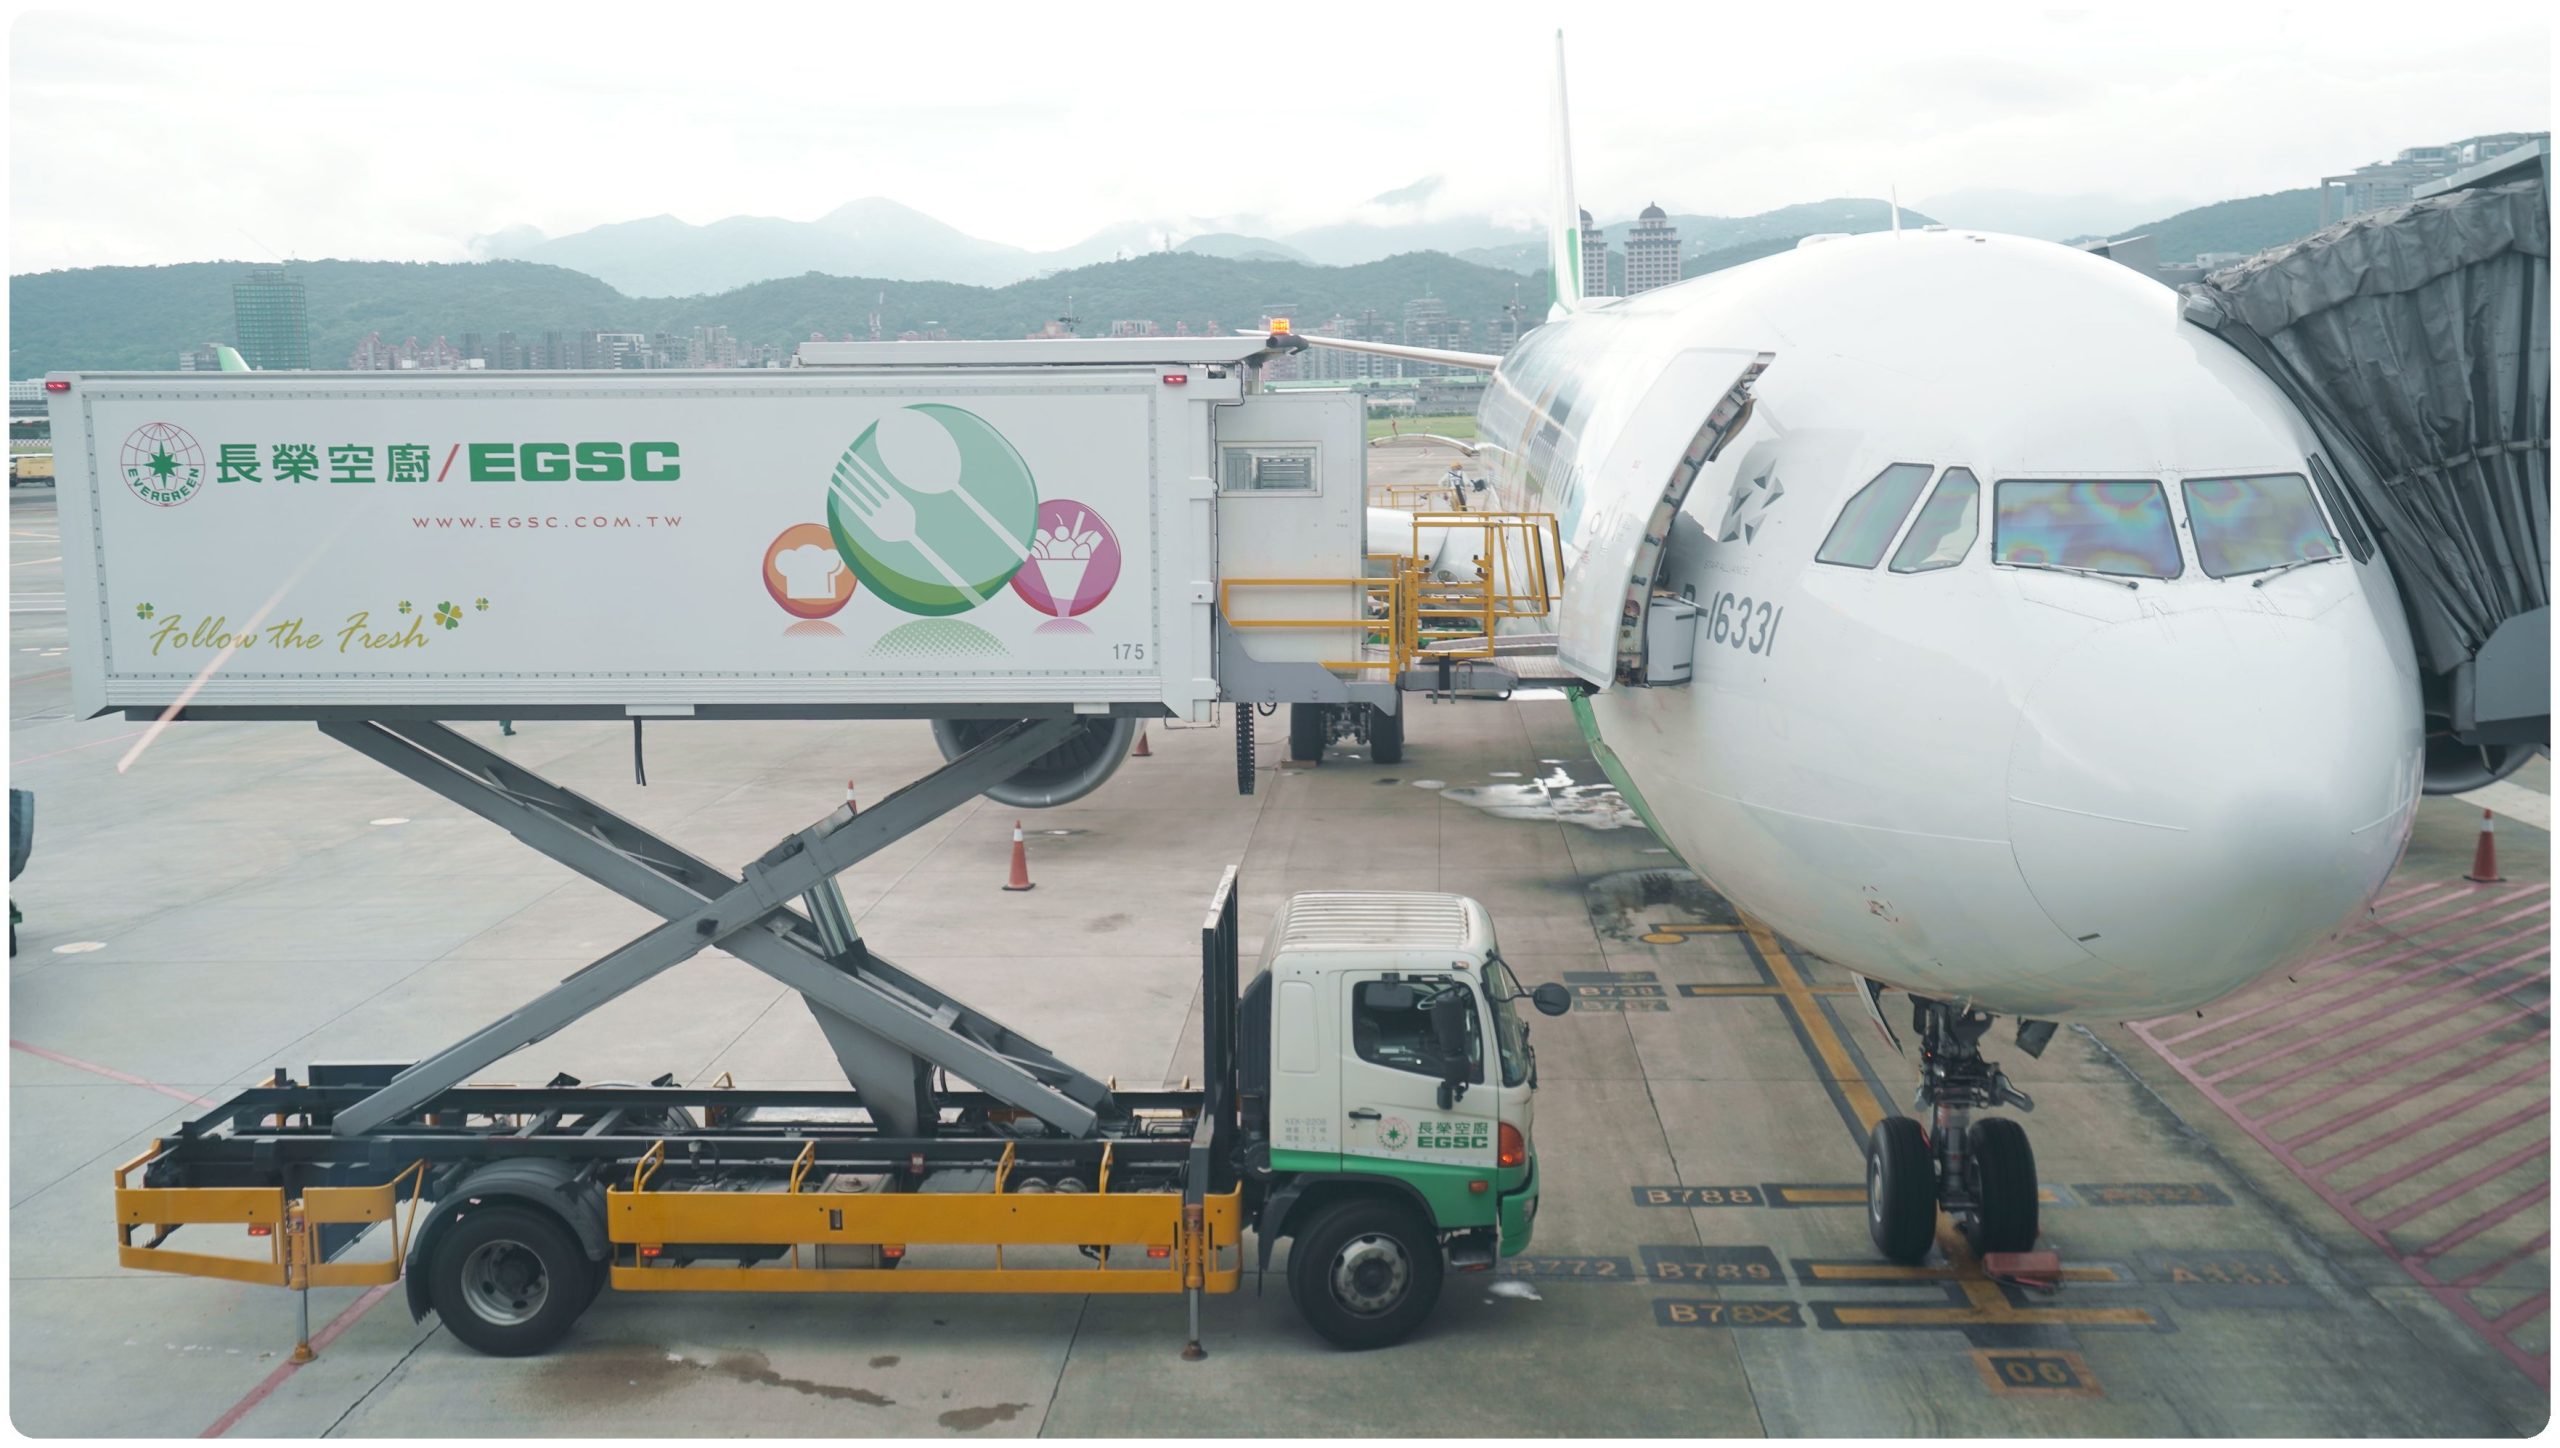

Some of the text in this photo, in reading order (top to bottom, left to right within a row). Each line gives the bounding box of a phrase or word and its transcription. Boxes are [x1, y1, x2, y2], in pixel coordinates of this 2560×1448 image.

[215, 443, 431, 483] 長榮空廚
[468, 442, 681, 482] EGSC
[127, 467, 200, 502] EVERGREEN
[412, 516, 683, 529] WWW.EGSC.COM.TW
[150, 611, 430, 657] Follow the Fresh
[1112, 643, 1145, 660] 175
[1417, 1136, 1489, 1149] EGSC
[1647, 1188, 1753, 1204] B788
[1656, 1261, 1772, 1279] B789
[1668, 1303, 1793, 1324] B78X
[2005, 1361, 2067, 1384] 06
